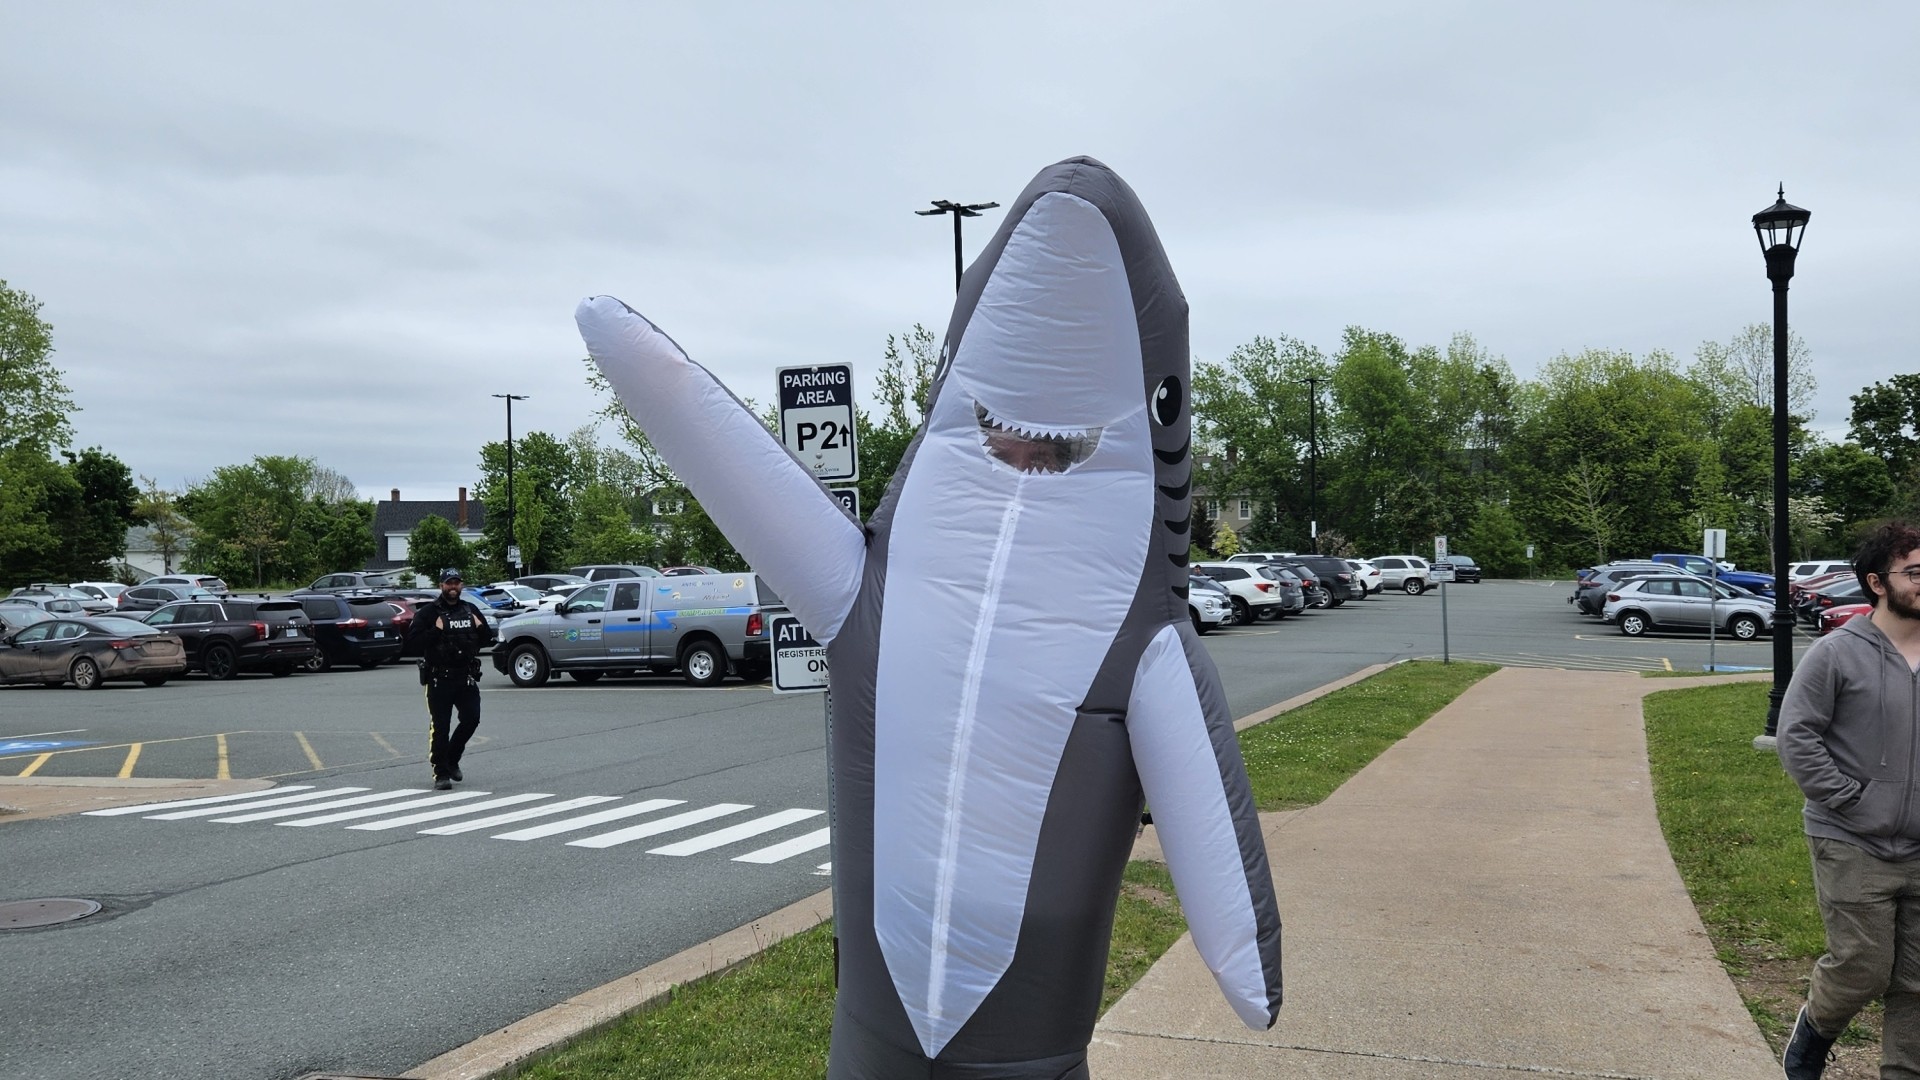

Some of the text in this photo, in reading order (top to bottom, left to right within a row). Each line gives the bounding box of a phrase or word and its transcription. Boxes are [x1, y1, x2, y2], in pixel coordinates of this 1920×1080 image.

[783, 371, 846, 388] PARKING
[796, 390, 836, 405] AREA
[797, 421, 839, 451] P2
[449, 619, 471, 629] POLICE
